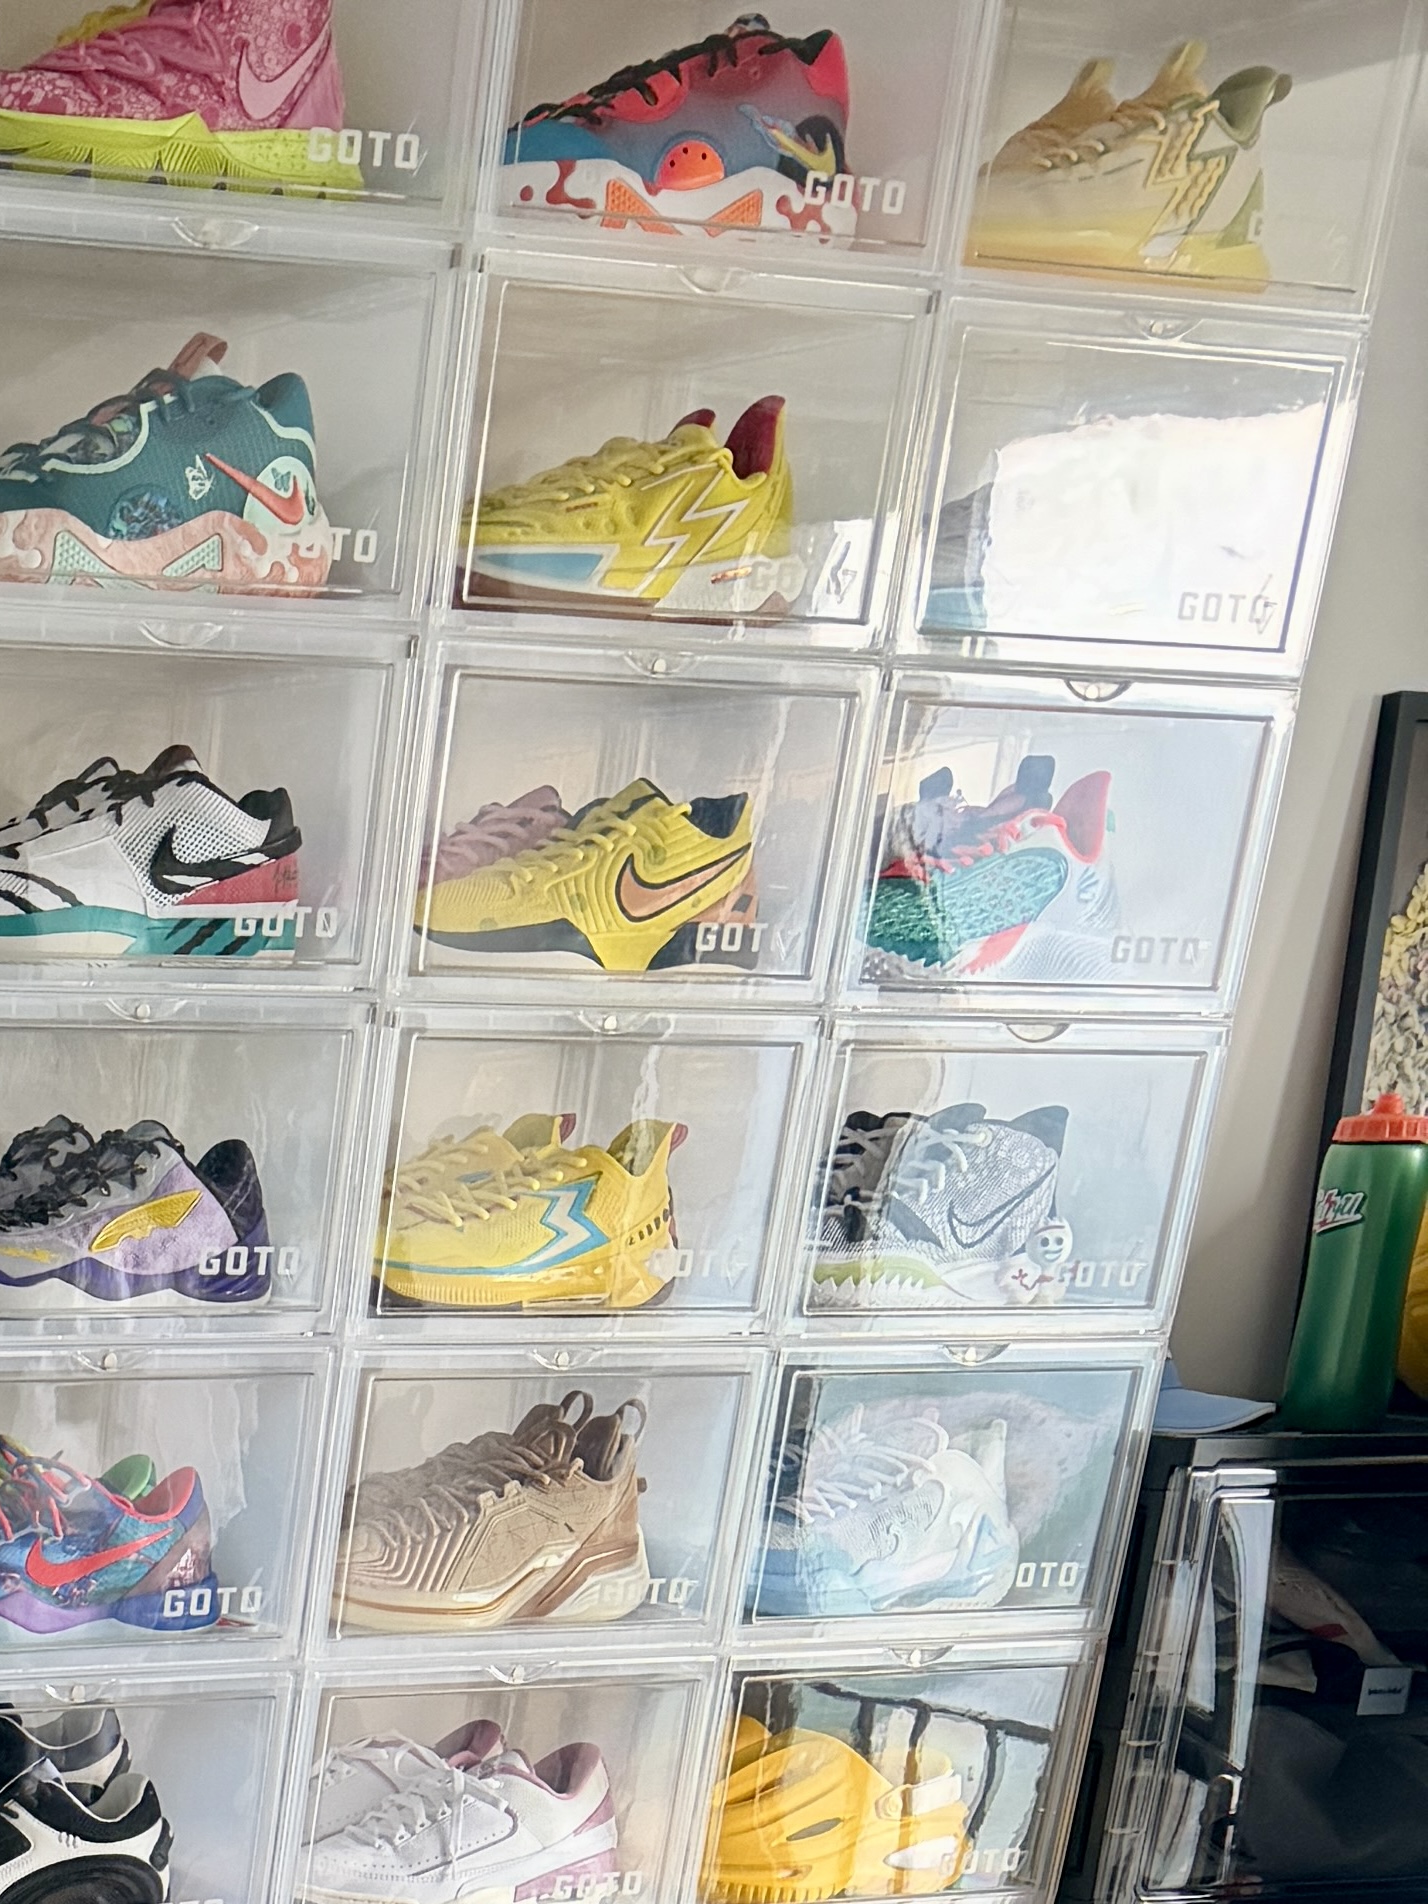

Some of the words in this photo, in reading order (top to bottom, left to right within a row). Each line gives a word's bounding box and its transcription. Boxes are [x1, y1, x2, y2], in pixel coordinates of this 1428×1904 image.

[307, 127, 420, 169] GOTO
[805, 170, 906, 214] GOTO
[233, 907, 337, 939] GOTO
[198, 1246, 298, 1277] GOTO
[1012, 1562, 1079, 1589] OTO
[162, 1587, 262, 1616] GOTO
